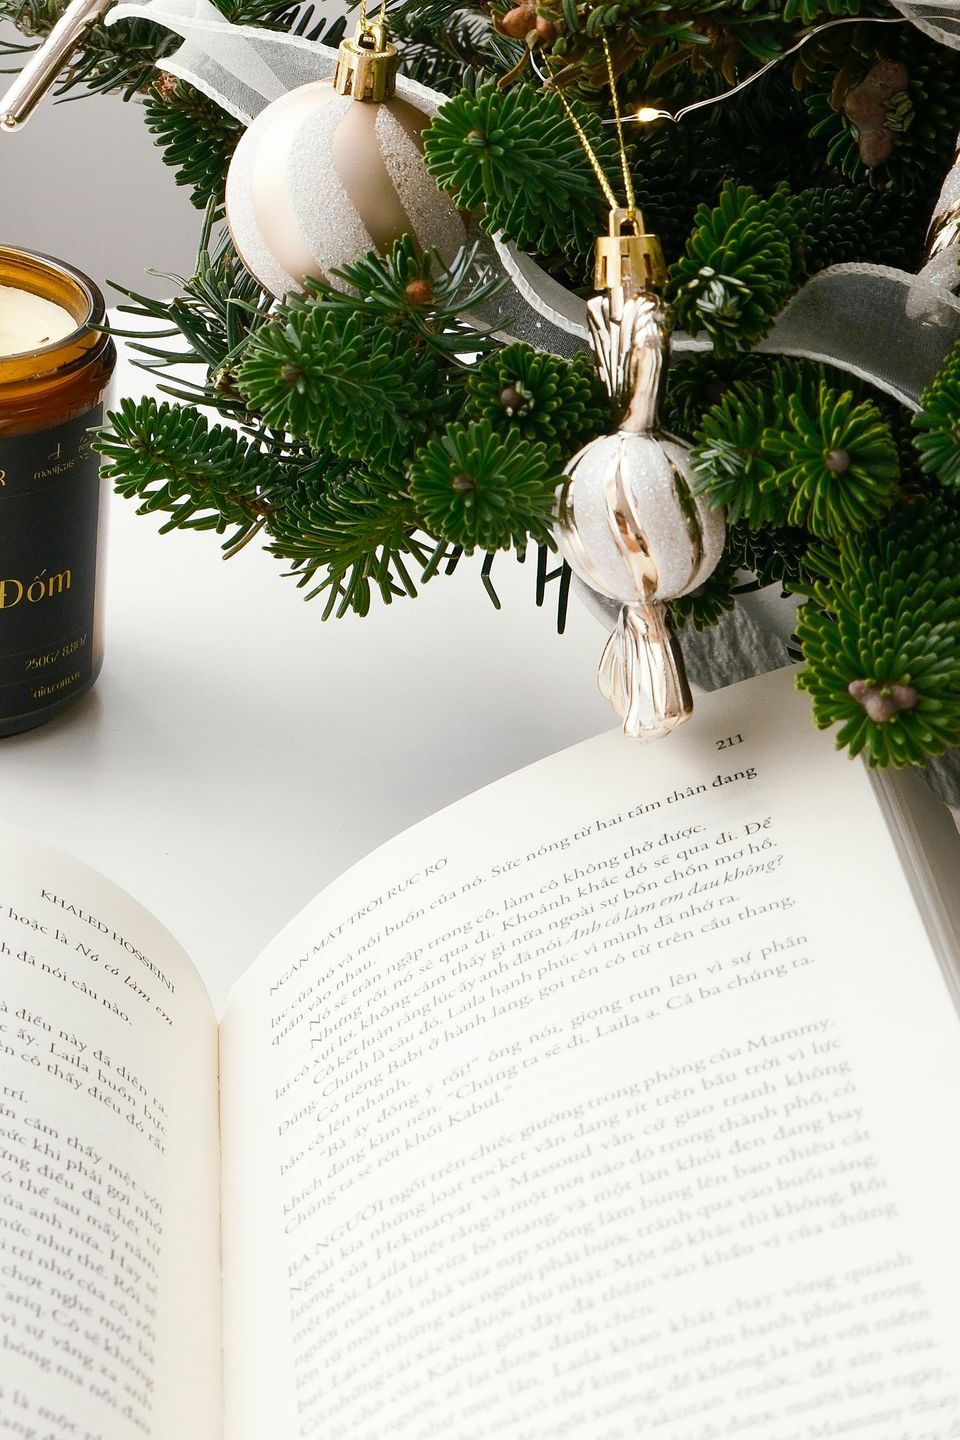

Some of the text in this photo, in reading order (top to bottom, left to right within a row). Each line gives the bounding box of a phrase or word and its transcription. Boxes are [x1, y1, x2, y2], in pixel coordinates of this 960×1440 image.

[715, 733, 744, 751] 211
[711, 767, 758, 788] đang
[40, 889, 175, 994] KHALED HOSSEINI
